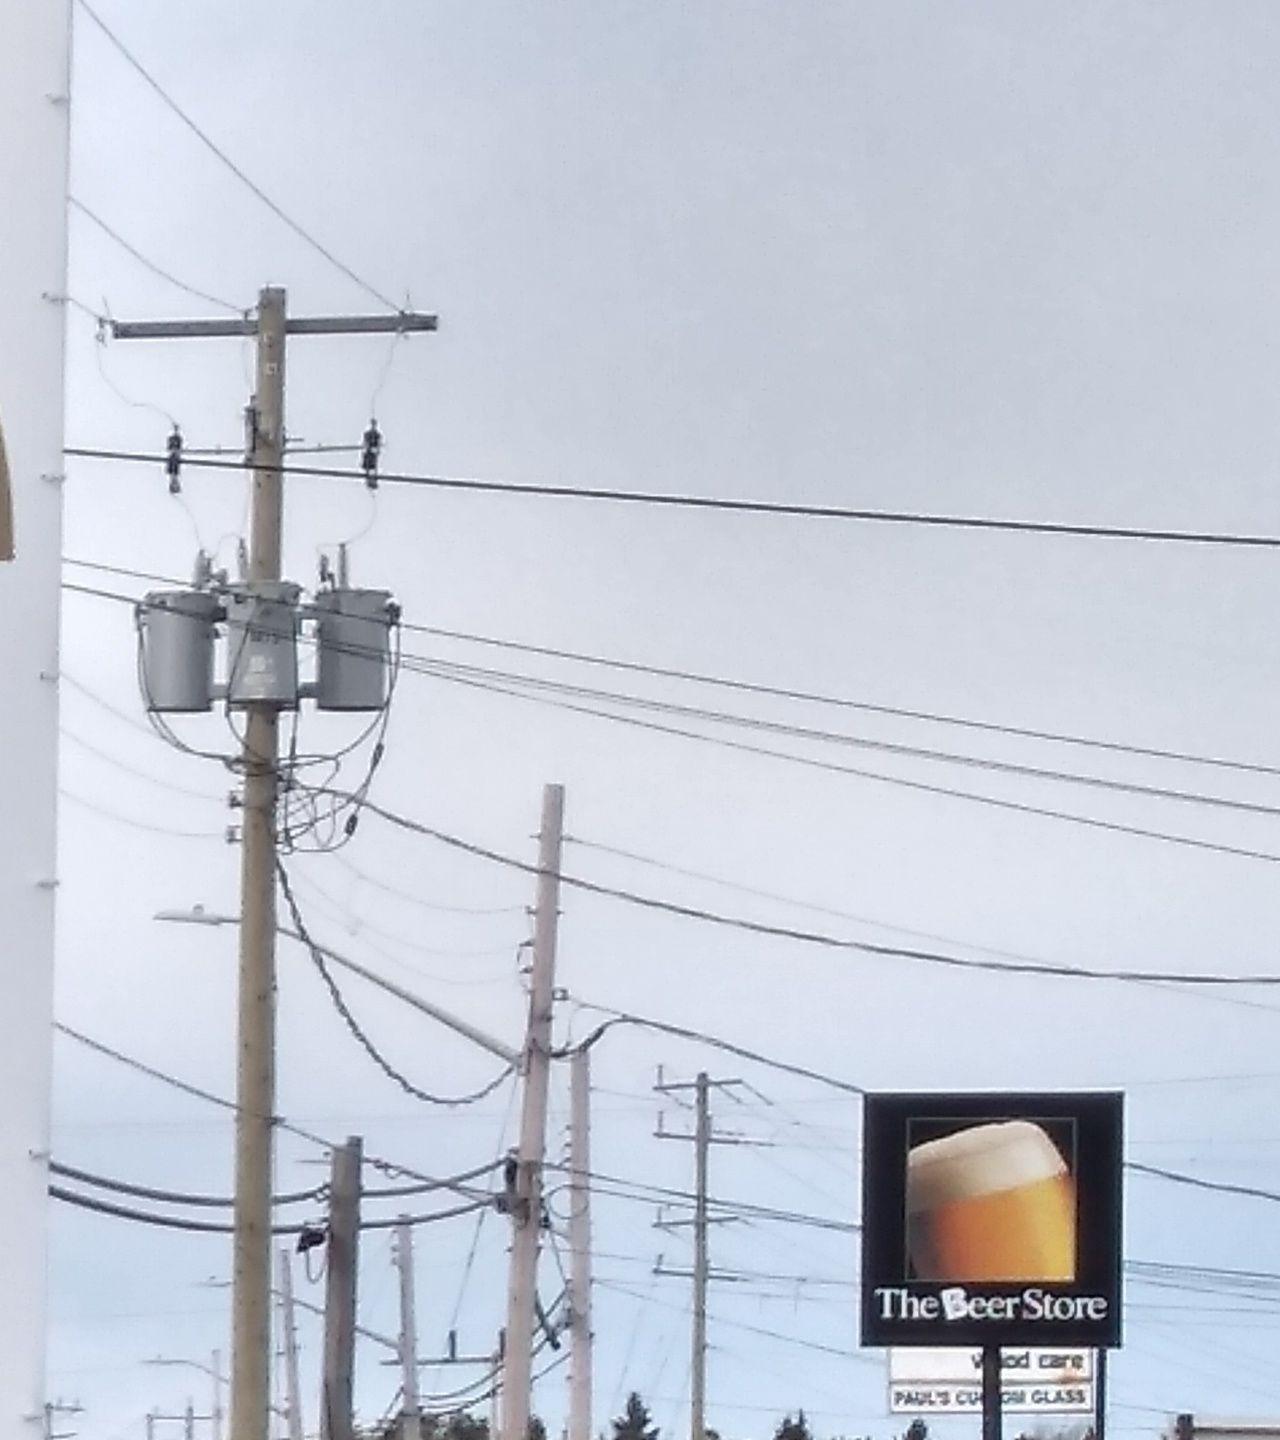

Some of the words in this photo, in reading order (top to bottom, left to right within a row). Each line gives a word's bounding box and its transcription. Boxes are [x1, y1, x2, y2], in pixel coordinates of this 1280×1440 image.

[873, 1287, 939, 1320] The
[940, 1286, 1020, 1321] Beer
[1021, 1288, 1108, 1321] Store
[970, 1352, 1030, 1370] Wod
[955, 1390, 1027, 1406] CUOM
[1031, 1389, 1086, 1405] GLASS
